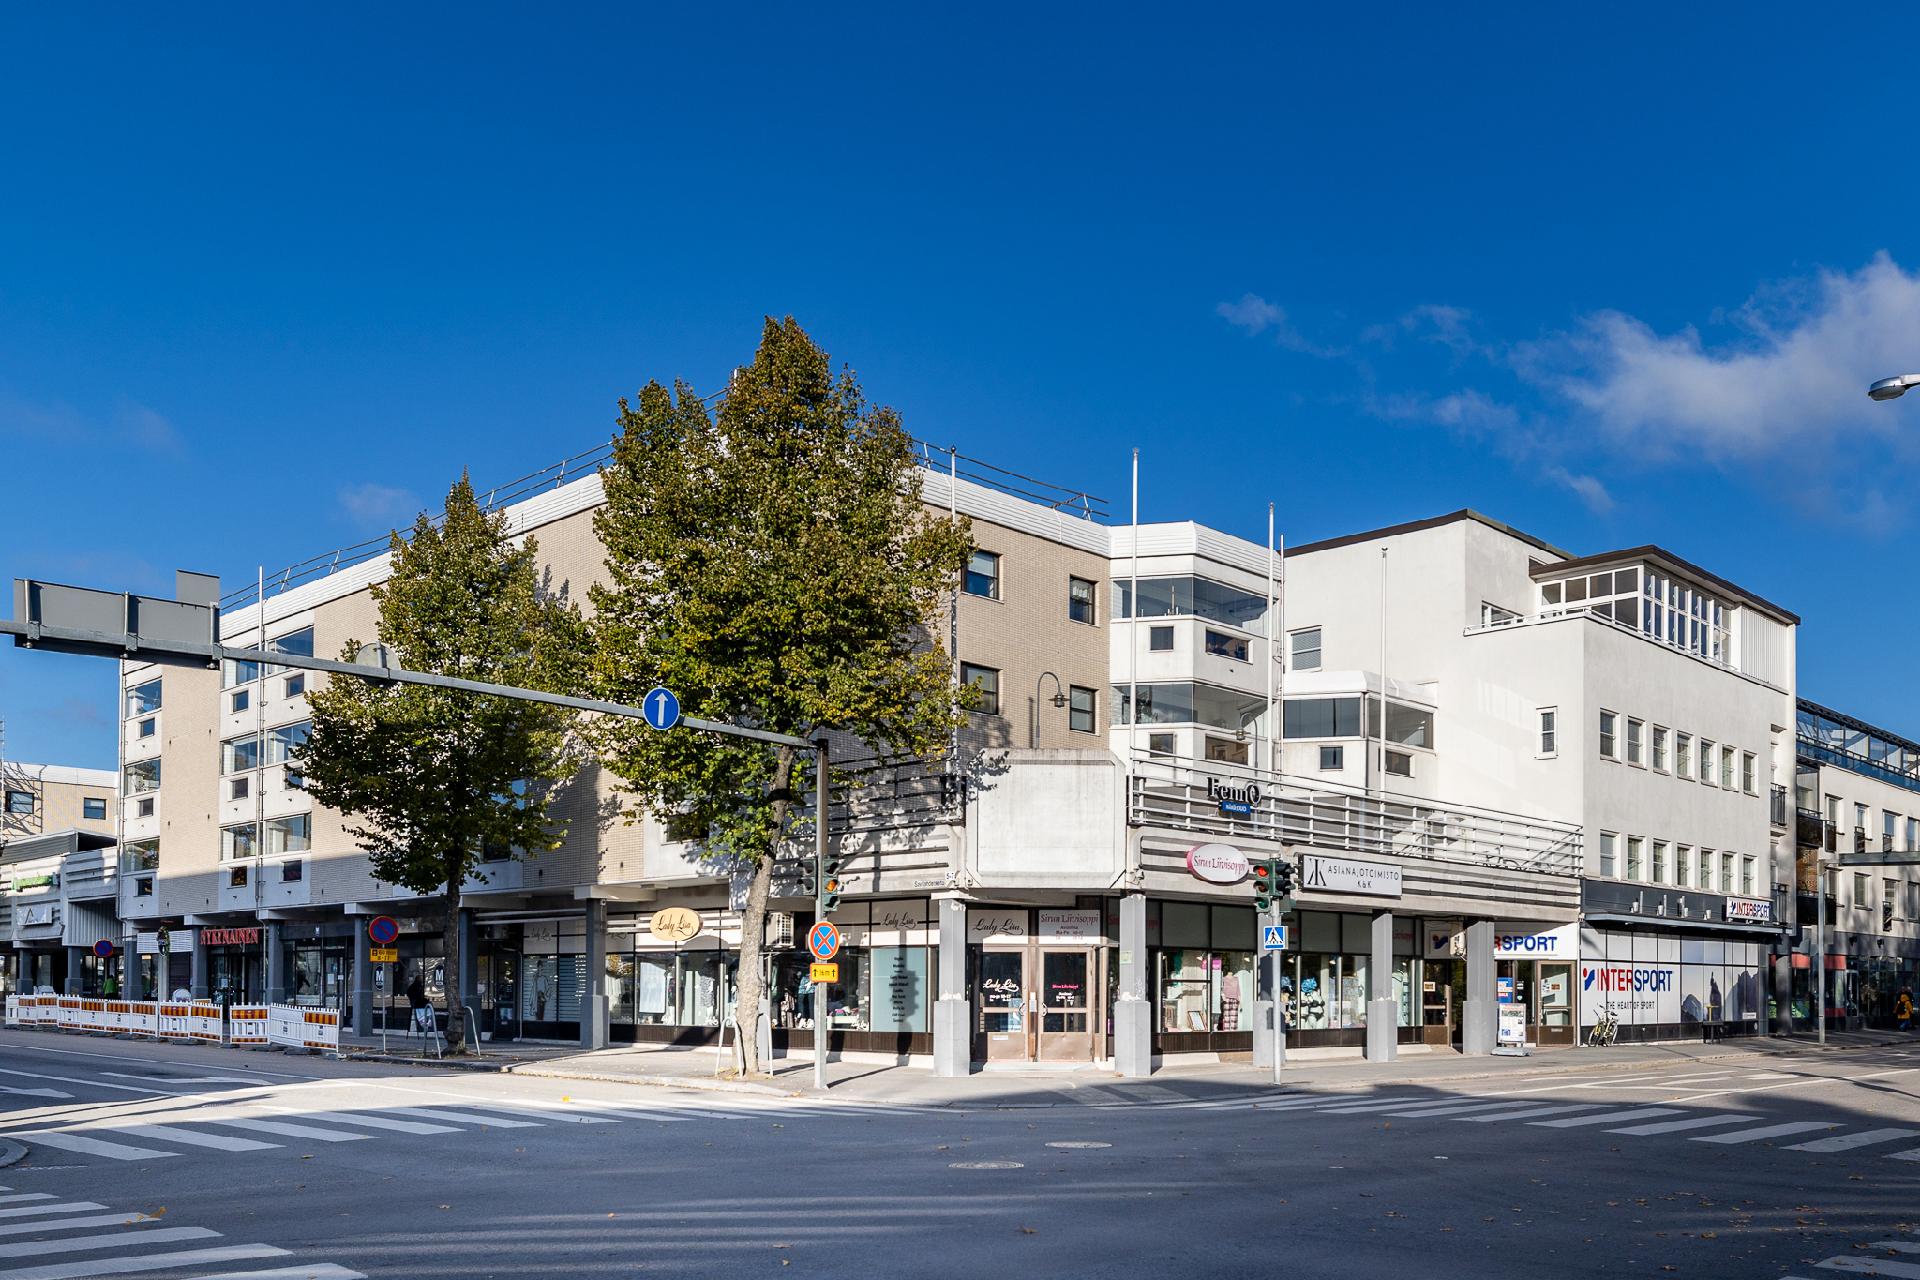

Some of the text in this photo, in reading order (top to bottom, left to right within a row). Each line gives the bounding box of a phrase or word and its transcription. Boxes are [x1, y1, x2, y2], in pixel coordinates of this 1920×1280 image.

[1736, 901, 1771, 918] INTERSPORT
[656, 914, 675, 937] Lady
[973, 918, 998, 935] Lady
[1597, 967, 1673, 992] INTERSPORT
[1617, 1001, 1632, 1010] HEART
[1633, 1001, 1640, 1010] OF
[1640, 1001, 1655, 1010] SPORT
